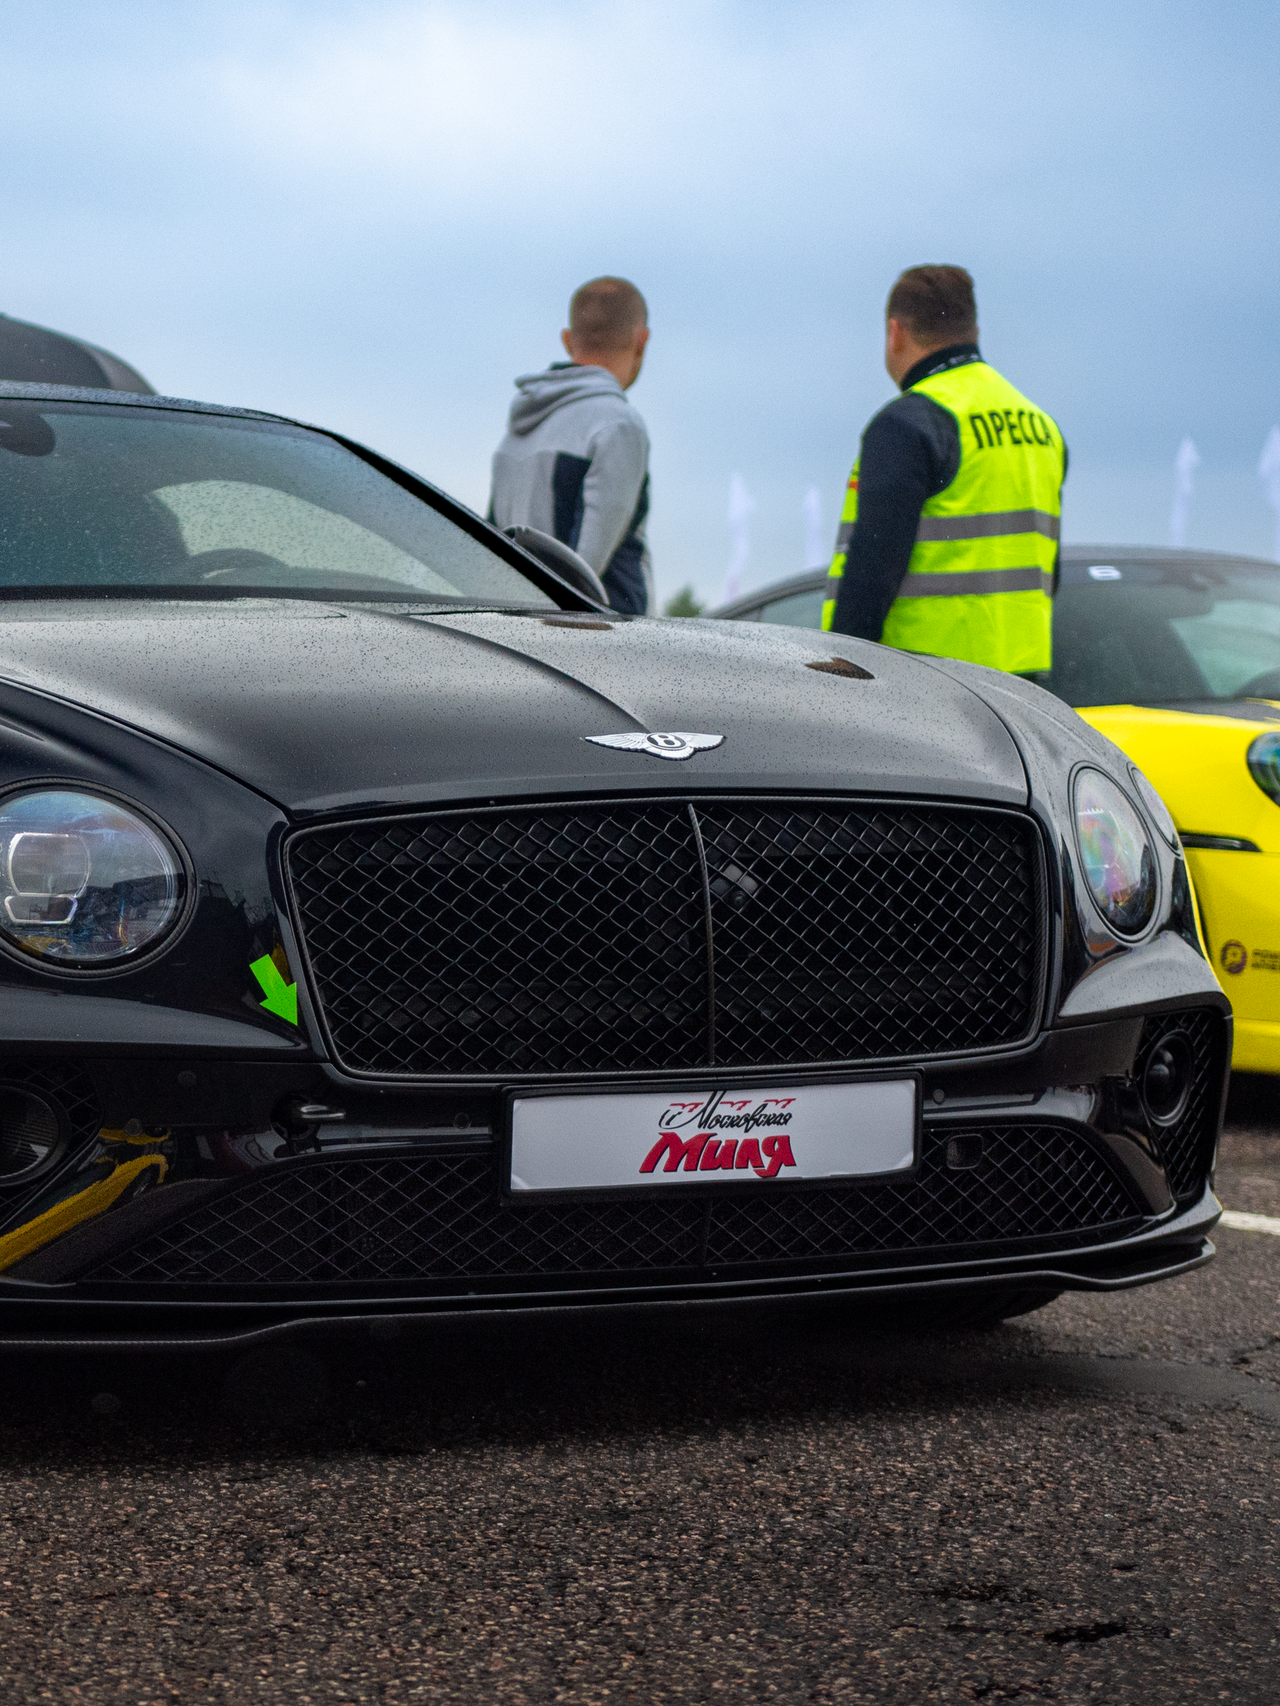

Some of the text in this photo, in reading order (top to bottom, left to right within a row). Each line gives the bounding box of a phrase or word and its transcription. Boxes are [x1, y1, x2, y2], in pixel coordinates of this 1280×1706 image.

[970, 409, 1055, 449] ПРЕССА
[659, 1090, 793, 1133] Московская
[639, 1132, 797, 1178] Миля
